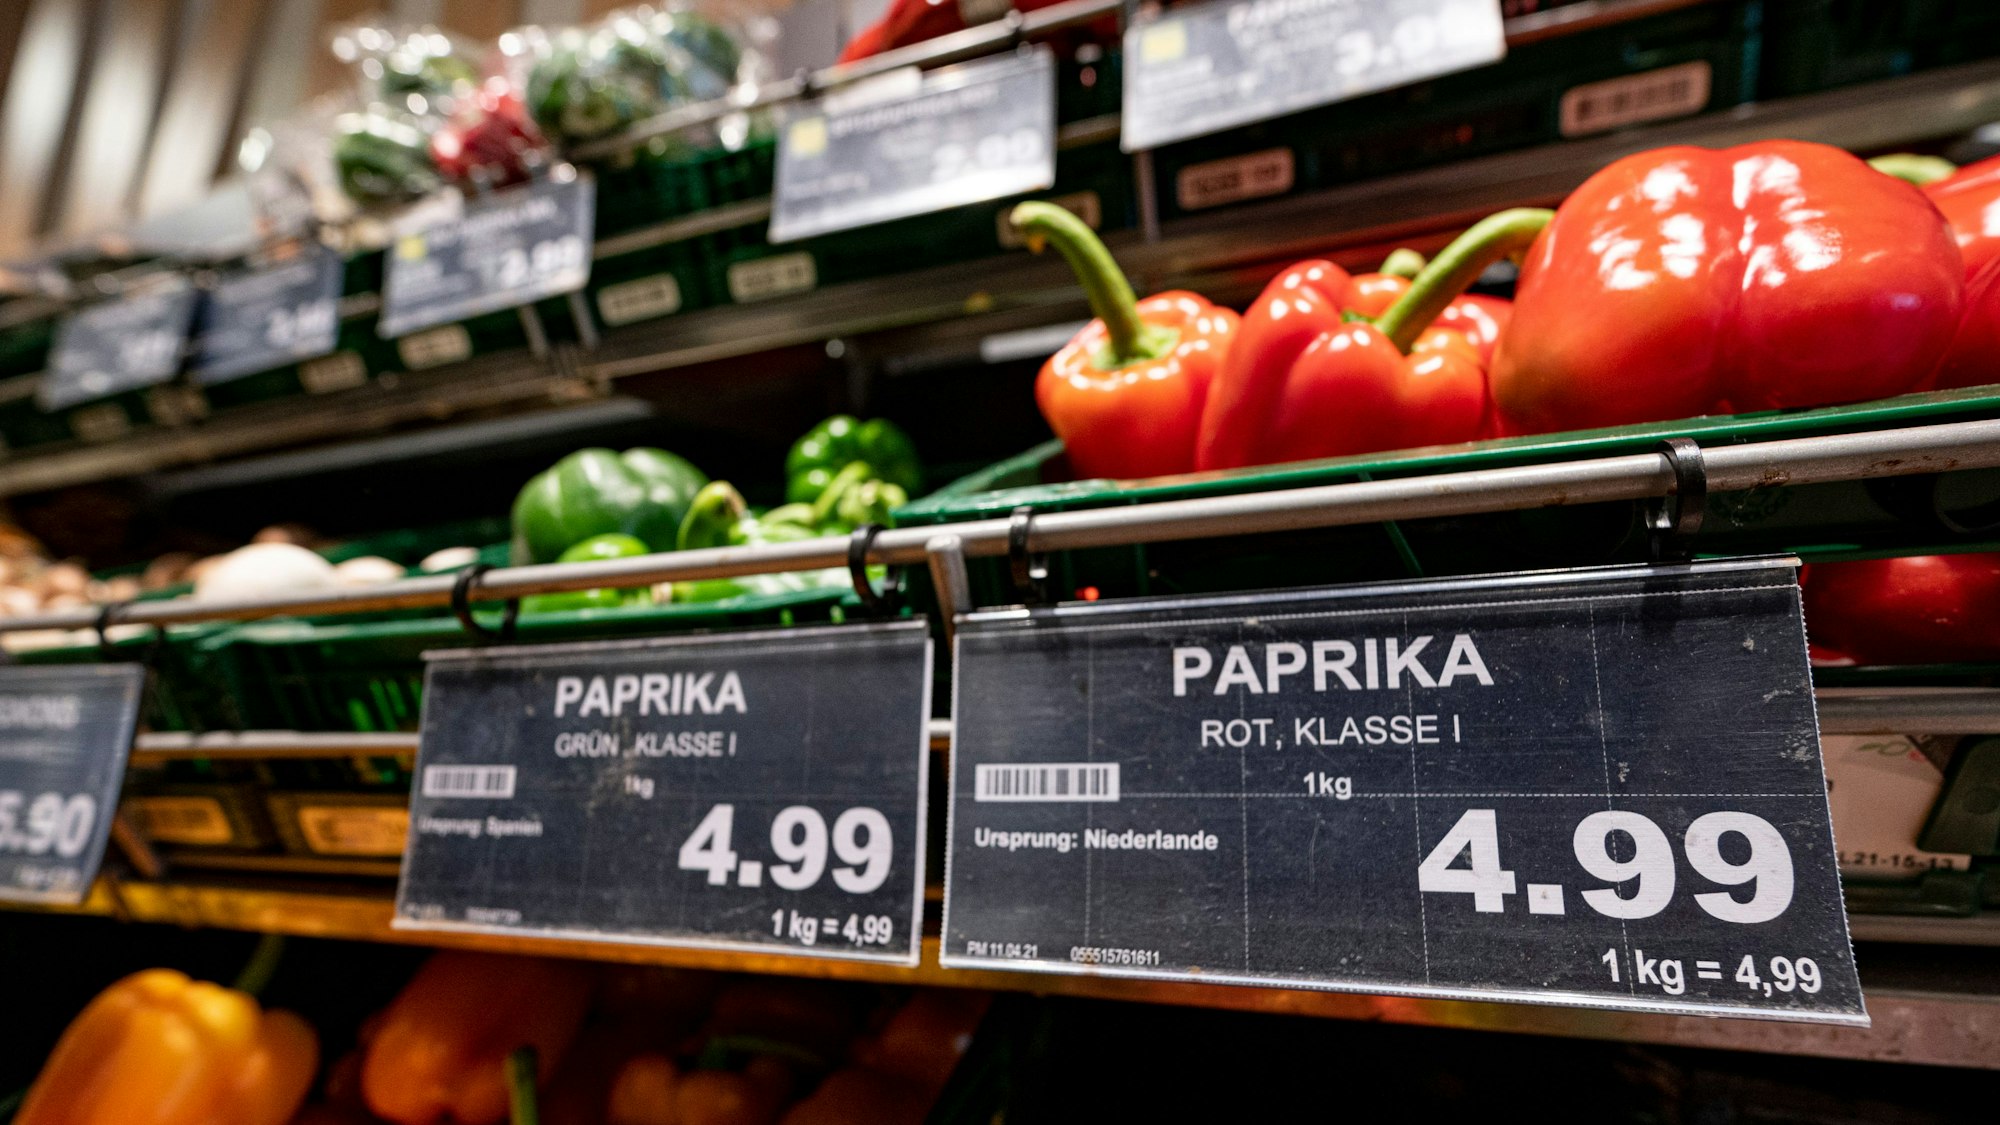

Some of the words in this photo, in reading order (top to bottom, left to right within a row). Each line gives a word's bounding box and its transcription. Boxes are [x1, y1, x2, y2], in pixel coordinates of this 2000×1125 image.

[1171, 632, 1495, 697] PAPRIKA
[553, 671, 747, 717] PAPRIKA
[635, 731, 725, 758] KLASSE
[1201, 717, 1283, 750] ROT,
[1294, 715, 1441, 746] KLASSE
[1453, 714, 1462, 743] I
[1302, 771, 1353, 801] 1kg
[678, 803, 893, 895] 4.99
[974, 827, 1079, 853] Ursprung:
[1084, 828, 1219, 852] Niederlande
[1418, 808, 1795, 925] 4.99
[771, 909, 781, 937] 1
[788, 911, 818, 947] kg
[842, 913, 893, 948] 4,99
[1602, 948, 1620, 982] 1
[1636, 949, 1686, 995] kg
[1696, 959, 1723, 981] =
[1735, 954, 1822, 996] 4,99
